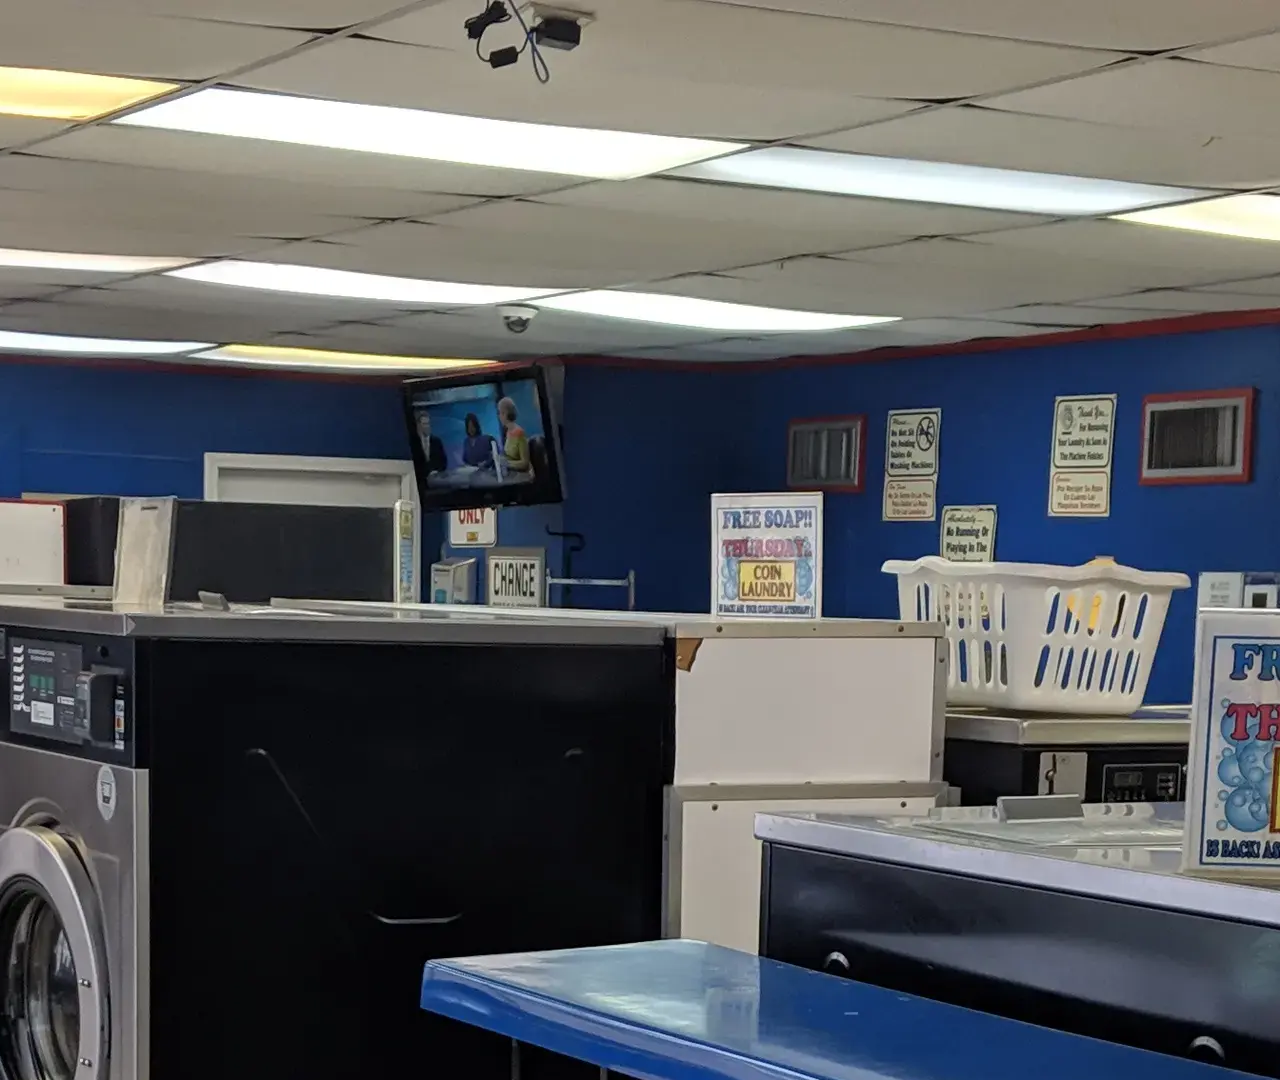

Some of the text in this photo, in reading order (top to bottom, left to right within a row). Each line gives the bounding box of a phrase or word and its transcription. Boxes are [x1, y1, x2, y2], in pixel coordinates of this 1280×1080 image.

[458, 509, 485, 525] ONLY
[723, 510, 812, 529] FREE SOAP!!
[946, 527, 989, 539] No Running Or
[946, 542, 987, 554] Playing In The
[493, 563, 536, 597] CHANGE
[754, 565, 781, 580] COIN
[742, 582, 793, 597] LAUNDRY
[1206, 839, 1220, 857] IS
[1221, 840, 1260, 859] BACK!
